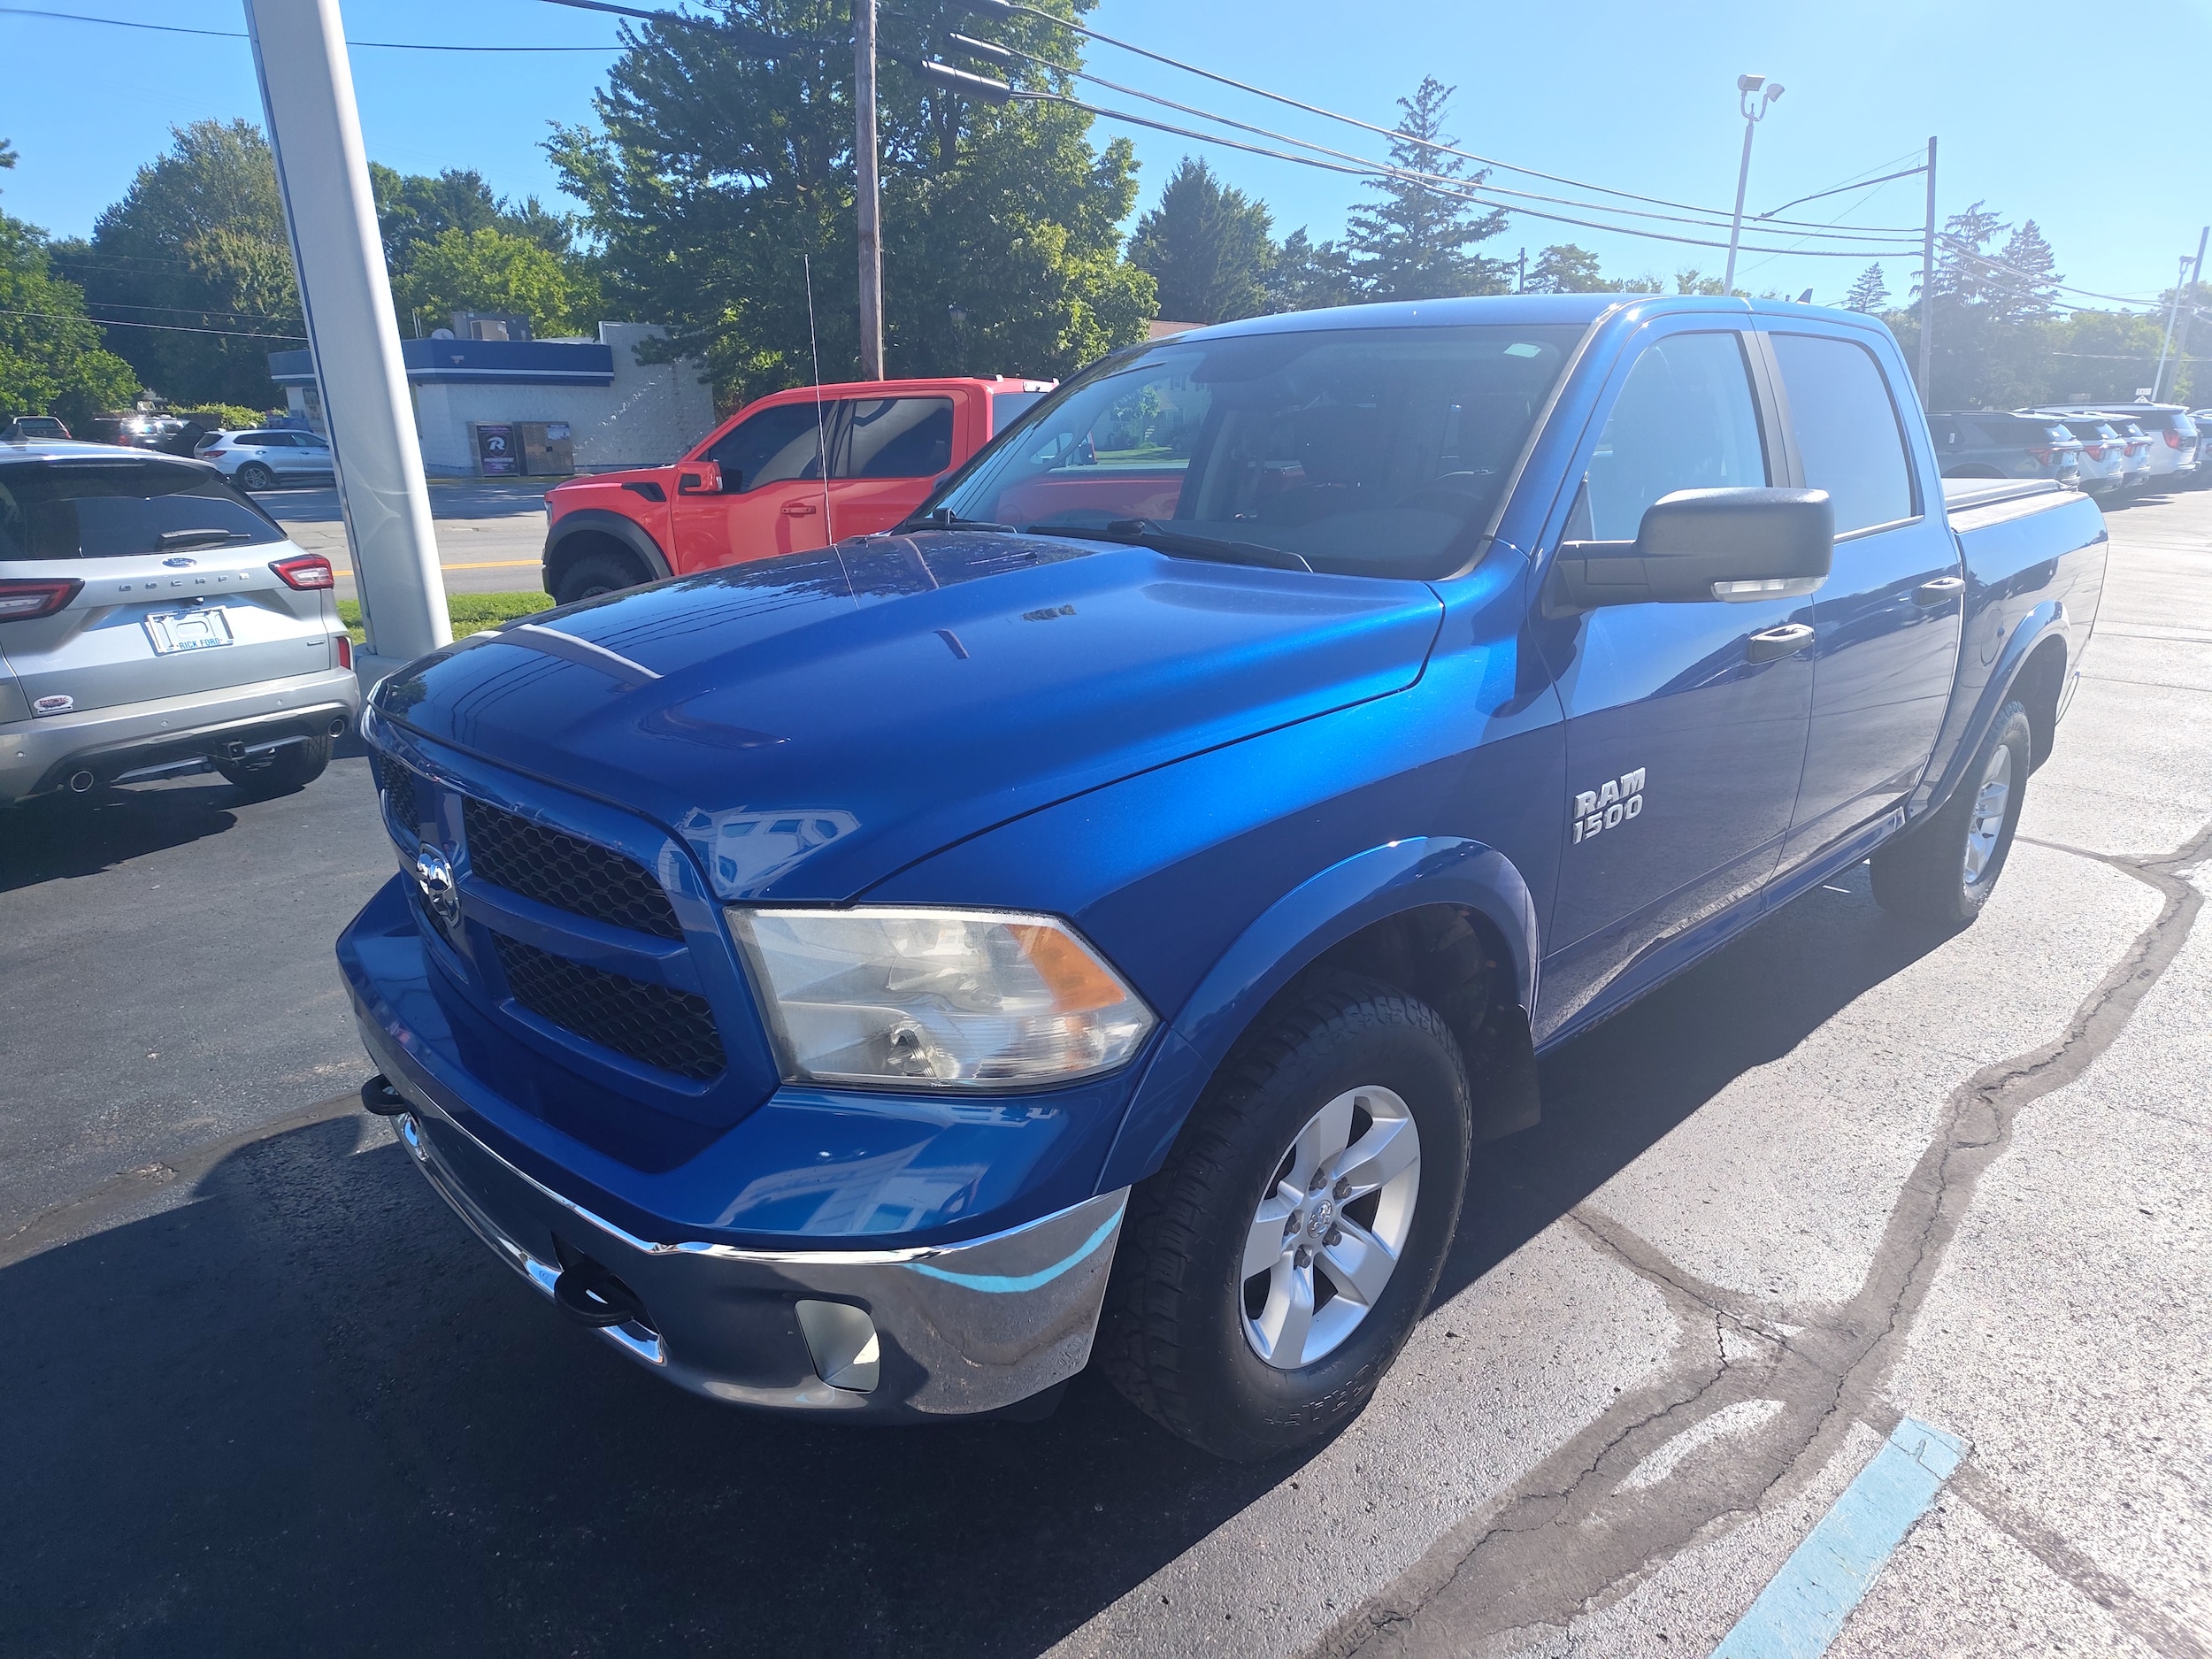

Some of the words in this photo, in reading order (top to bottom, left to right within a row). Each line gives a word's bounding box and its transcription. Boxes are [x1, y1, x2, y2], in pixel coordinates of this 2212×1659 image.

[180, 640, 197, 650] RICK
[199, 637, 221, 648] FORD
[1574, 766, 1646, 819] RAM
[1572, 794, 1644, 845] 1500
